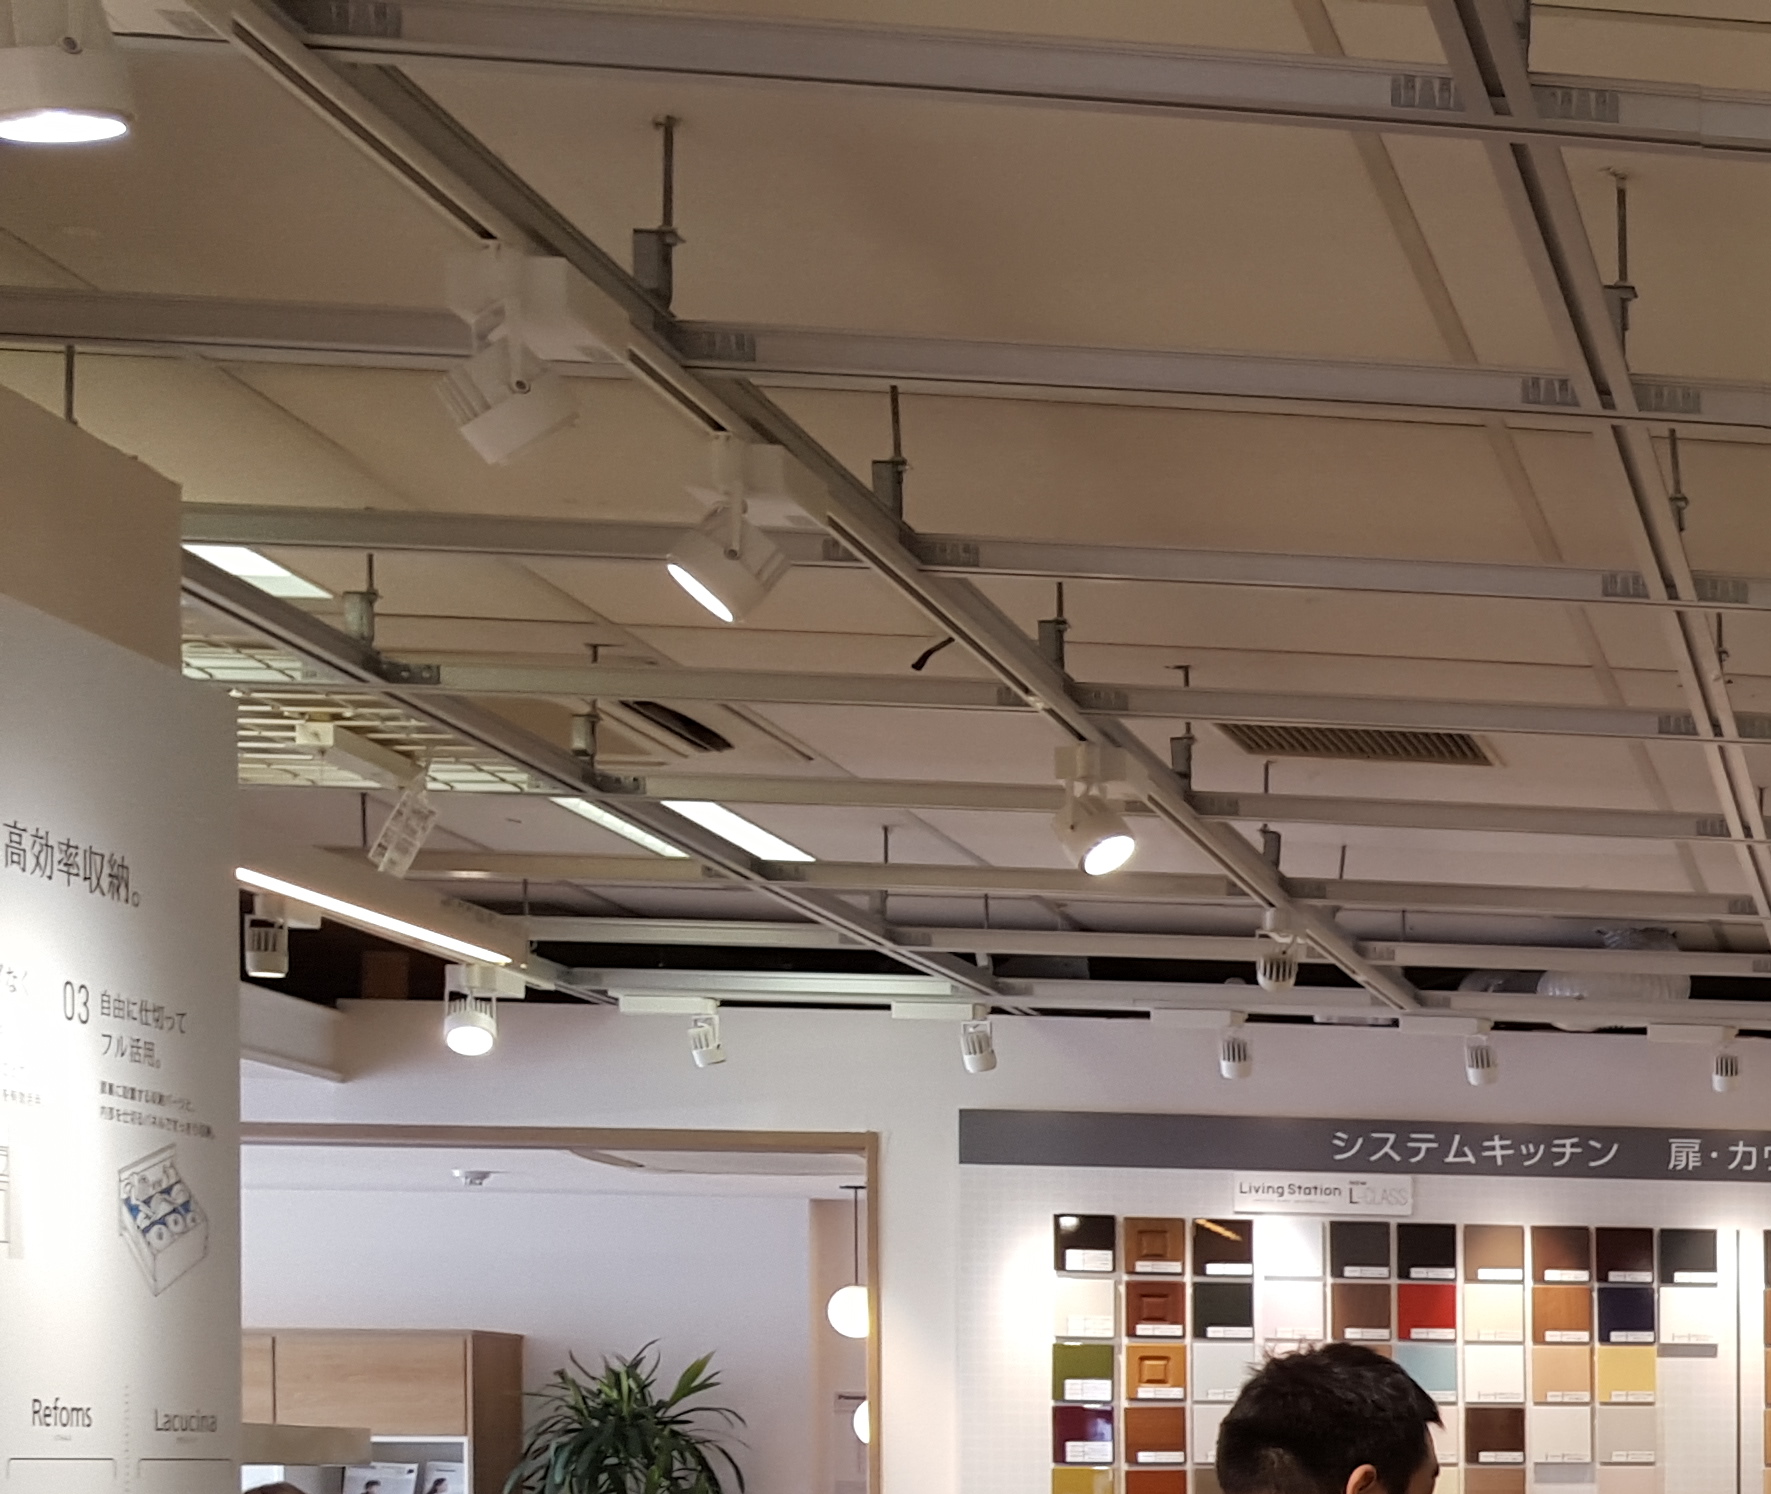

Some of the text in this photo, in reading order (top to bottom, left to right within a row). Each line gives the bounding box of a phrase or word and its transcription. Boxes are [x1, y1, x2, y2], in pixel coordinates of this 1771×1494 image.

[64, 981, 90, 1024] 03
[101, 989, 187, 1034] 自由に仕切って
[101, 1033, 161, 1069] フル活用。
[1331, 1130, 1620, 1169] システムキッチン
[1239, 1182, 1285, 1199] Living
[1287, 1183, 1342, 1197] Station
[32, 1397, 93, 1428] Refoms
[154, 1408, 218, 1432] Lacucina
